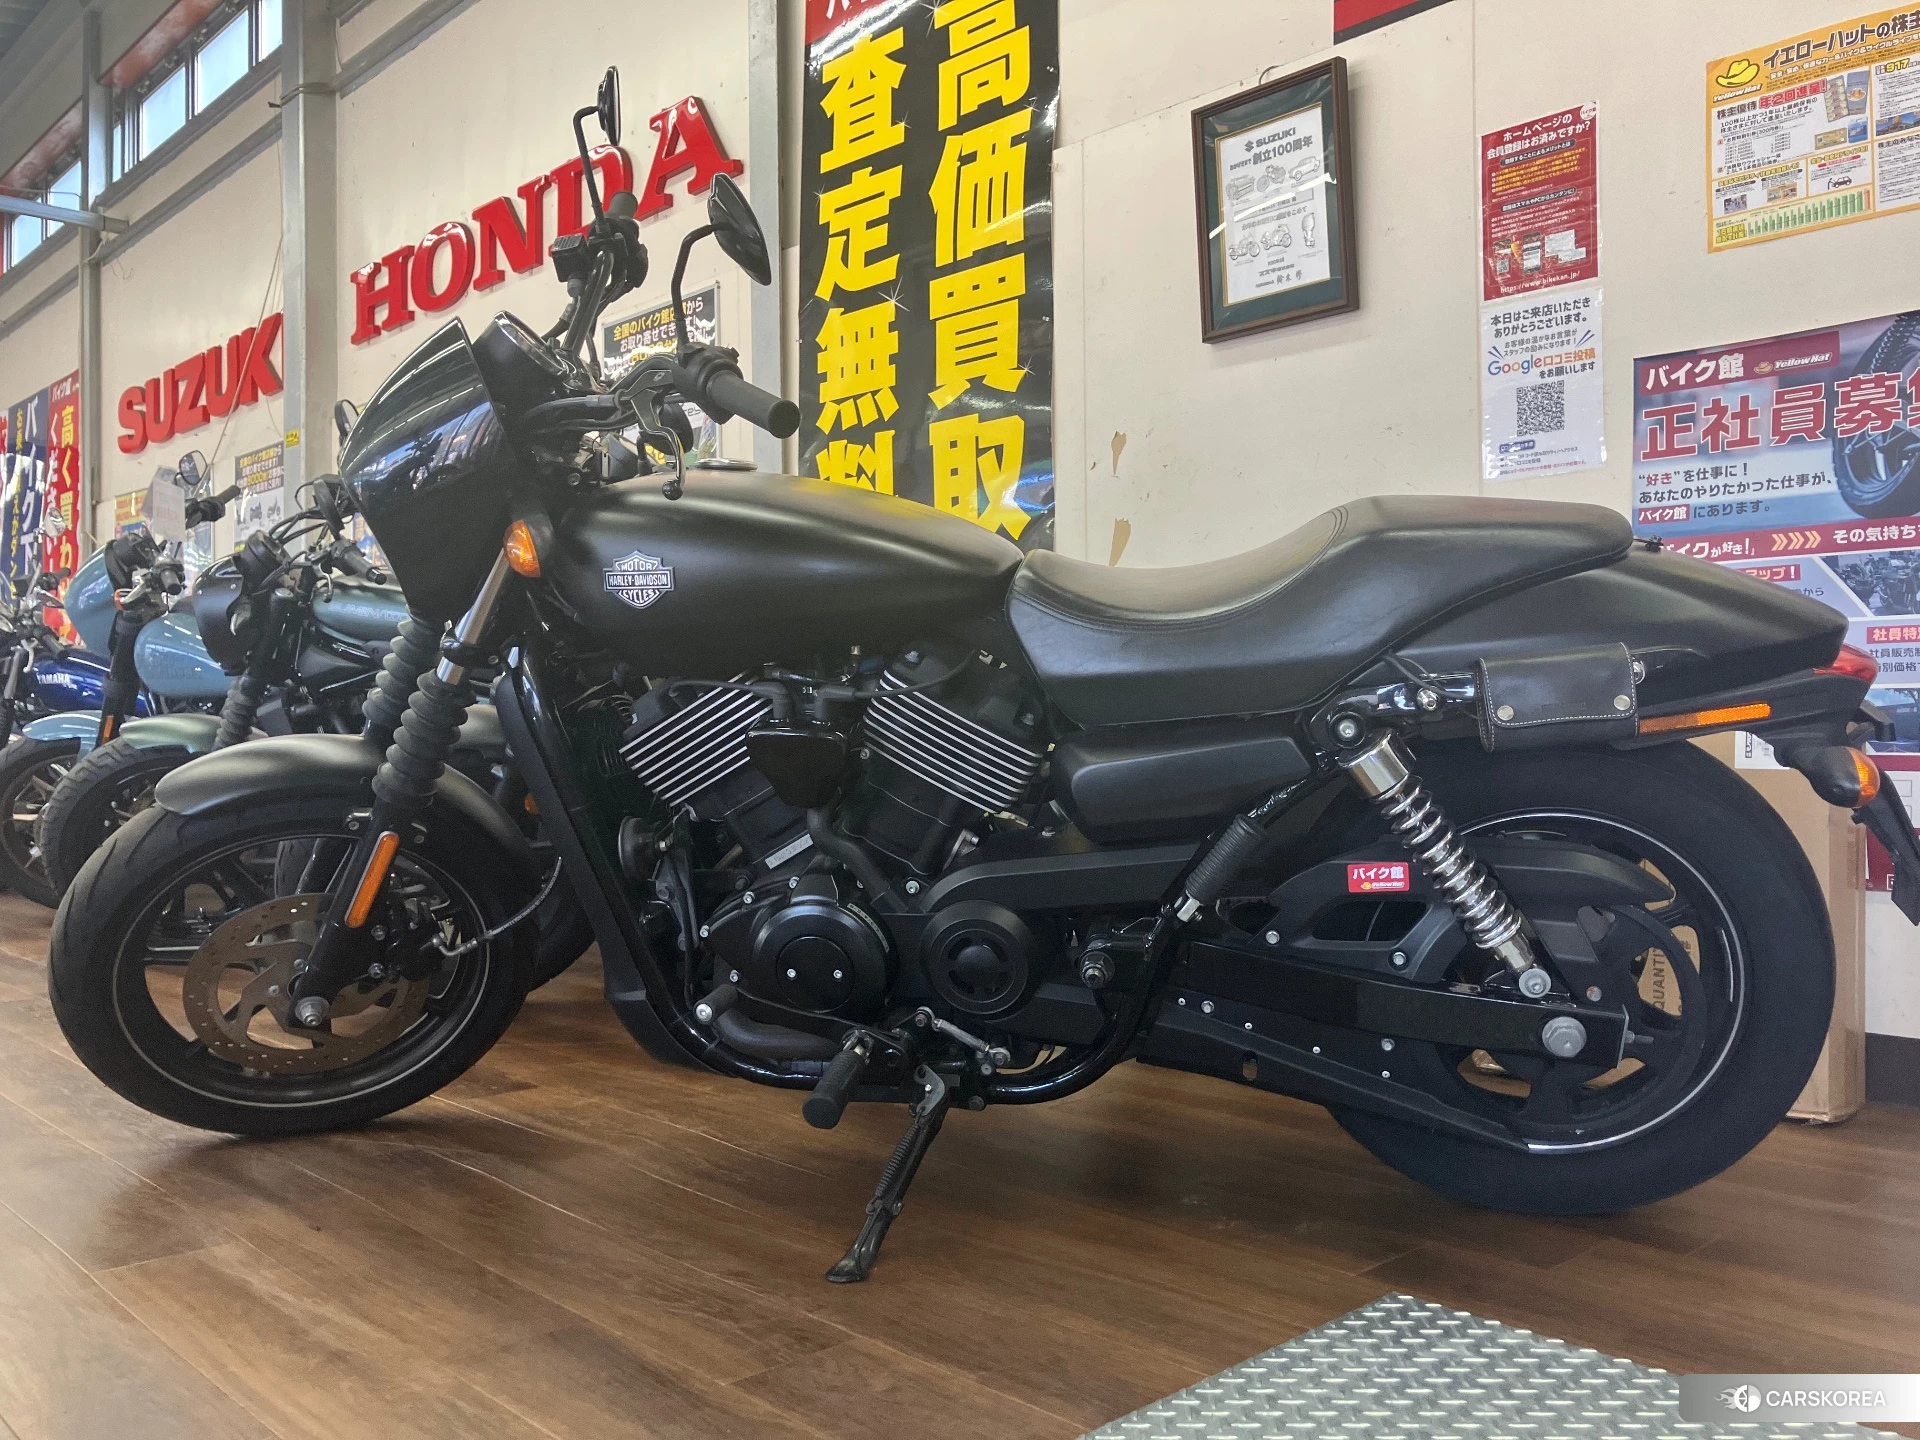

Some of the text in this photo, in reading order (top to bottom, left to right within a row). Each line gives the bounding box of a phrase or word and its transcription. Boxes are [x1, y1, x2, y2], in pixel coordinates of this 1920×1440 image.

[1255, 127, 1296, 148] SUZUKI
[1503, 113, 1573, 142] ホームページの
[1253, 135, 1313, 165] 創立100周年
[350, 96, 743, 345] HONDA
[816, 26, 906, 496] 査定無料
[928, 0, 1034, 540] 高価買取
[613, 296, 704, 342] 全国のバイク館店から
[1490, 297, 1591, 327] 本日はご来店いただき
[1494, 311, 1587, 339] ありがとうございます。
[1504, 328, 1578, 349] お客様の温かなお言葉が
[117, 313, 285, 454] SUZUK
[1539, 361, 1596, 379] をお願いします
[1645, 351, 1833, 391] バイク館 YellowHat
[1641, 367, 1920, 461] 正社員募
[1638, 471, 1833, 504] あなたのやりたかった仕事が、
[1639, 500, 1771, 523] バイク館 にあります。
[1832, 523, 1920, 544] その気持ち
[621, 558, 653, 572] MOTOR
[608, 574, 668, 587] HARLEY-DAVIDSON
[622, 589, 656, 604] CYCLES
[37, 672, 71, 684] YAMAHA
[1352, 866, 1405, 880] バイク館
[1652, 948, 1665, 1010] QUANTI
